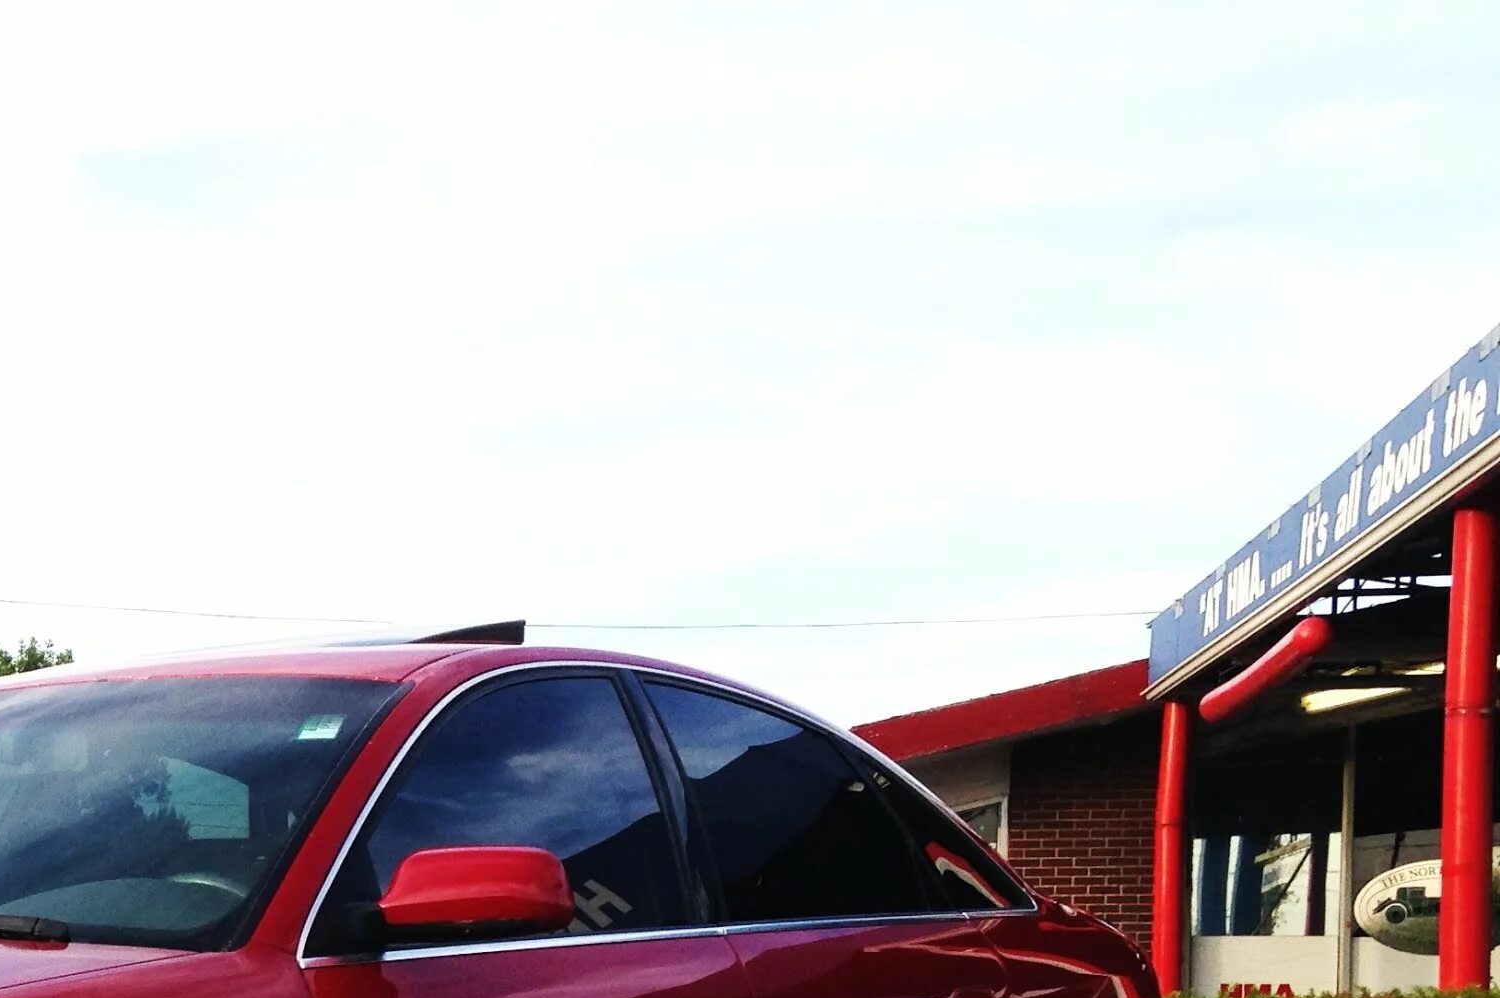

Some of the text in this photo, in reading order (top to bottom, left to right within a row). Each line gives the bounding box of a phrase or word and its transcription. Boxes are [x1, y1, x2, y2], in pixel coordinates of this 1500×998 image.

[1298, 503, 1329, 570] It's
[1334, 465, 1363, 541] all
[1367, 409, 1434, 516] about
[1443, 377, 1487, 457] the
[1382, 871, 1406, 888] THE
